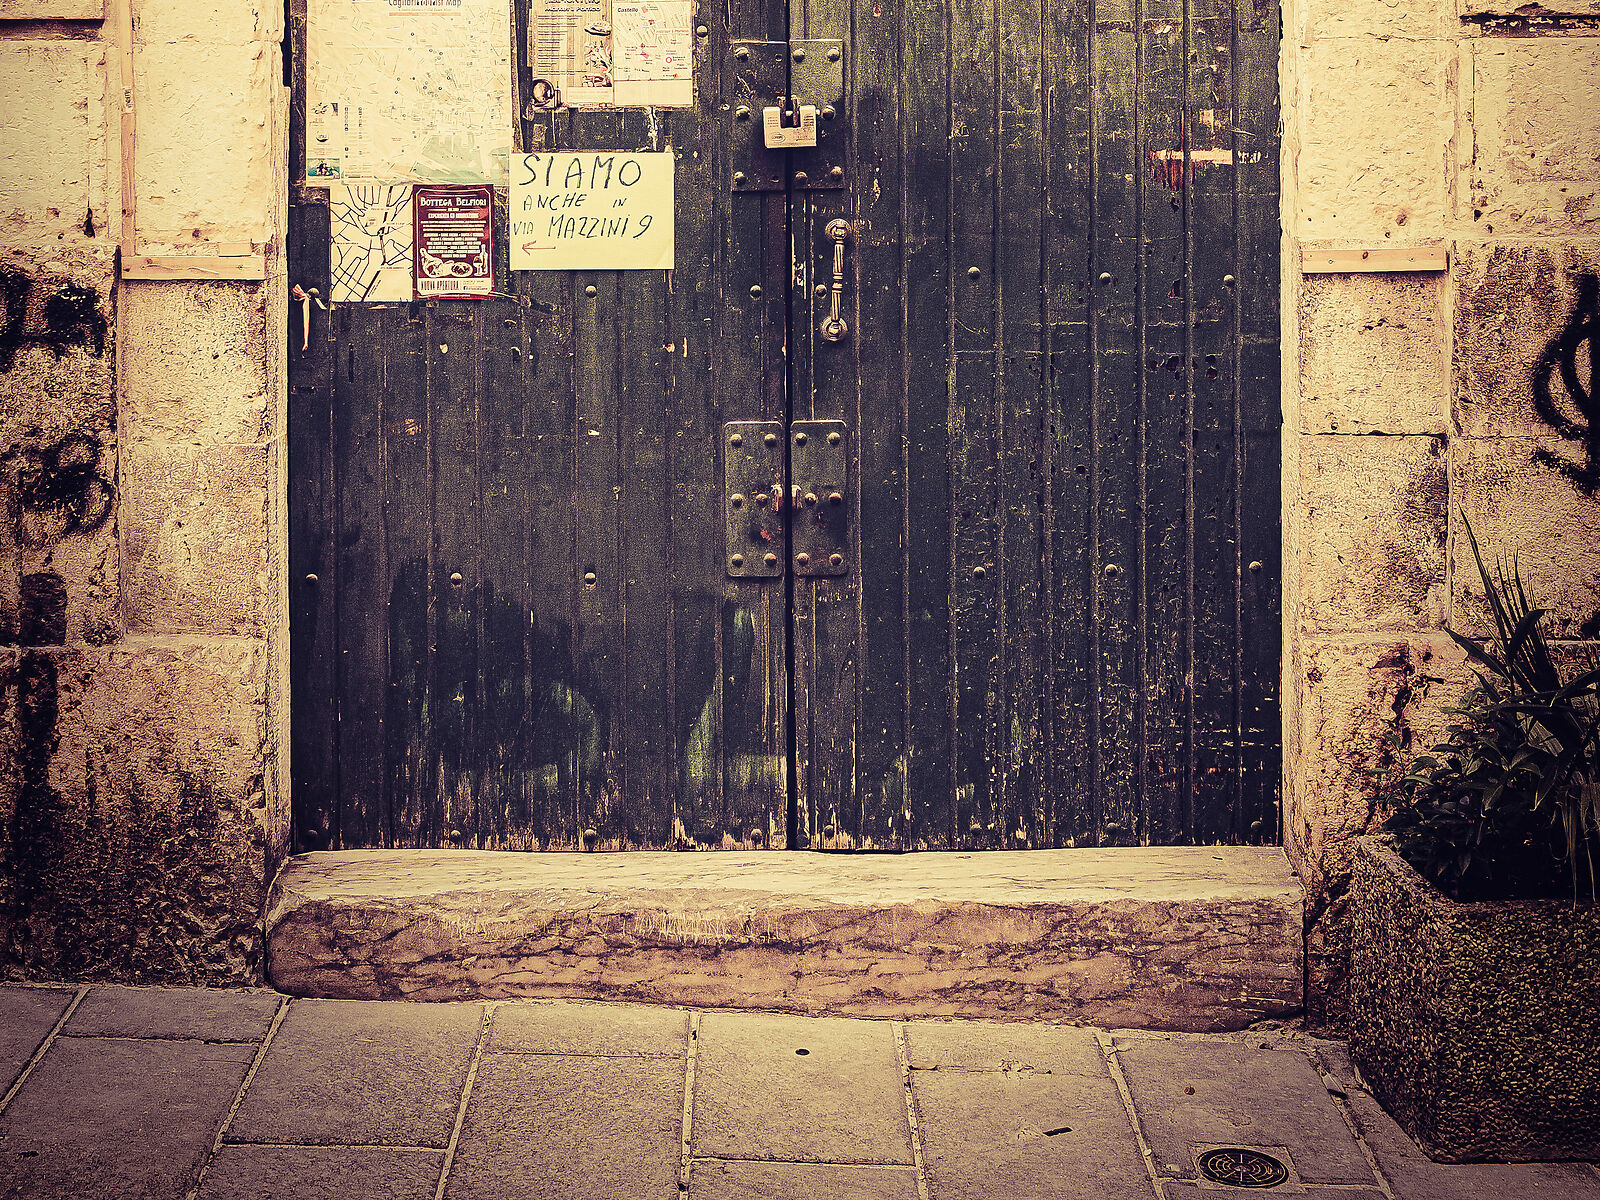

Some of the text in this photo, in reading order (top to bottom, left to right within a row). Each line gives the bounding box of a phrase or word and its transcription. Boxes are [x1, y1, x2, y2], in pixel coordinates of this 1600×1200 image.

[518, 153, 642, 190] SIAMO
[419, 196, 453, 207] BOTTEGA
[522, 192, 627, 212] ANCHE IN
[513, 221, 535, 236] VIA
[547, 213, 631, 239] MAZZINI
[632, 214, 653, 240] 9
